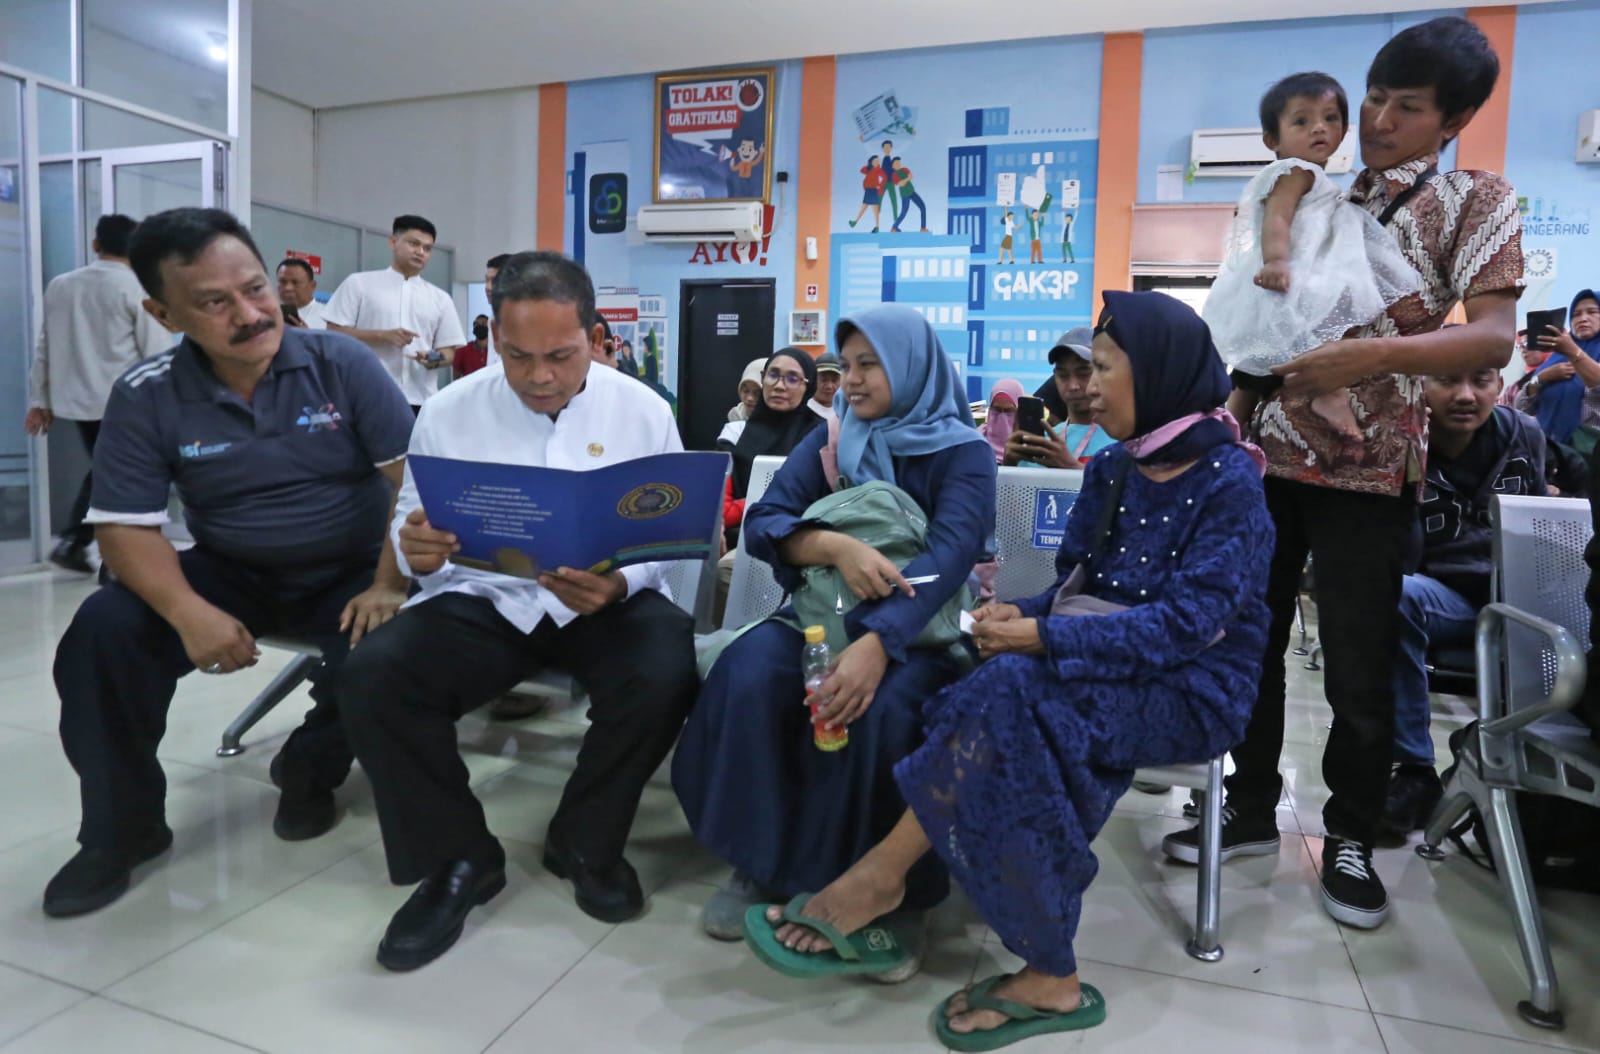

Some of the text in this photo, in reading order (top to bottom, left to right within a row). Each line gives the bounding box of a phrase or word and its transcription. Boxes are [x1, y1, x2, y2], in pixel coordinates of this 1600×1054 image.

[671, 85, 733, 104] TOLAK!
[668, 110, 737, 126] GRATIFIKASI
[1521, 223, 1590, 236] ANGERANG
[1041, 536, 1064, 545] TEMPA
